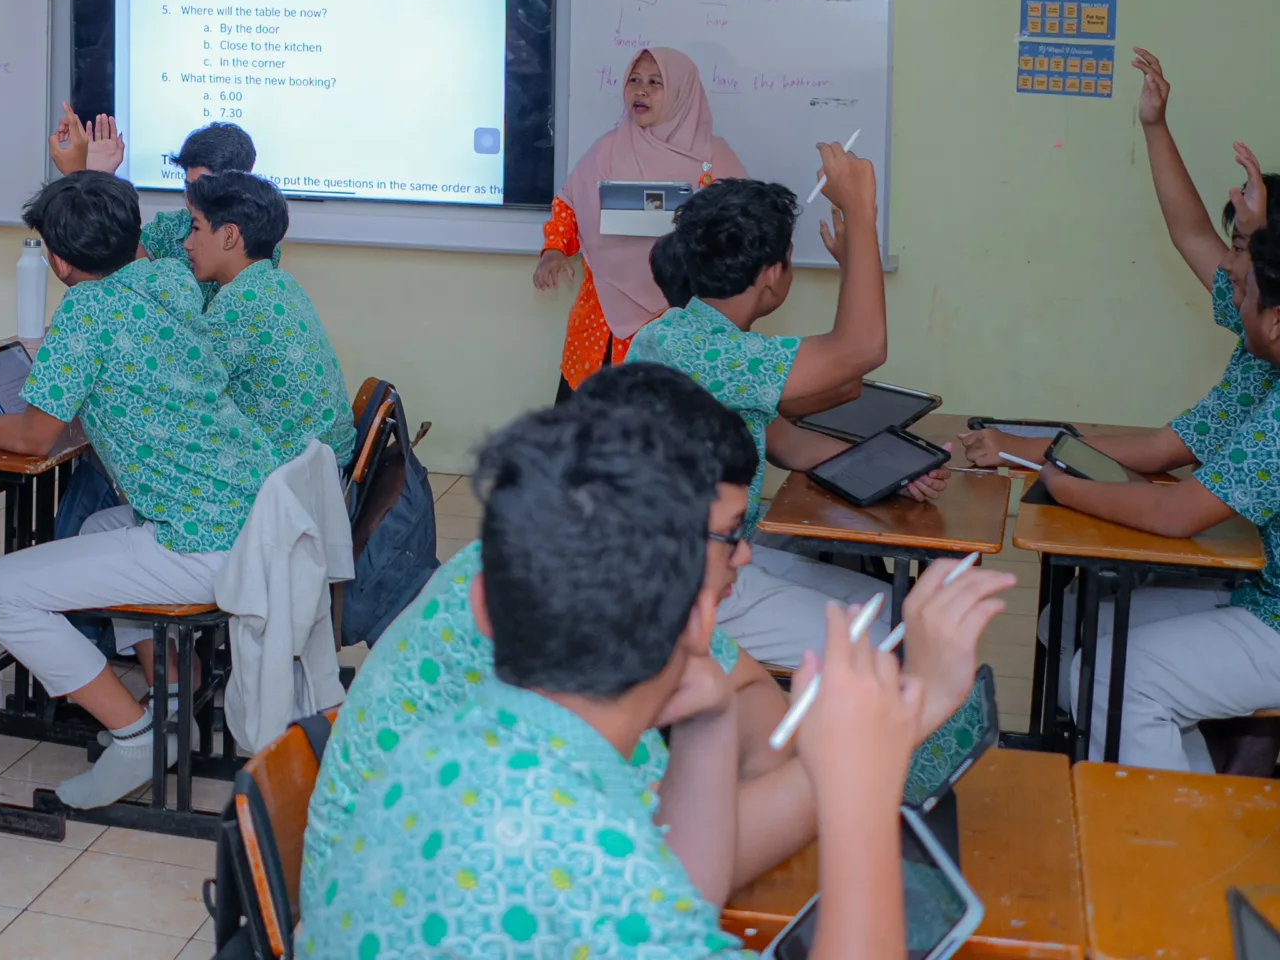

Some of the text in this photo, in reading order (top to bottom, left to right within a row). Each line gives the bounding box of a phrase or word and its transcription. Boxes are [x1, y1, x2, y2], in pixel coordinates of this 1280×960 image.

[161, 5, 327, 18] 5. Where will the table be now?
[203, 24, 280, 35] a. By the door
[203, 40, 323, 53] b. Close to the kitchen
[203, 57, 286, 68] c. In the corner
[161, 72, 337, 90] 6. What time is the new booking?
[595, 66, 618, 89] The
[753, 74, 775, 90] the
[203, 91, 243, 101] a. 6.00
[203, 107, 243, 118] b. 7.30
[161, 169, 186, 180] Write
[271, 175, 281, 185] to
[283, 176, 300, 187] put
[303, 176, 320, 186] the
[323, 178, 374, 190] questions
[376, 179, 386, 189] in
[390, 180, 407, 191] the
[410, 182, 438, 192] same
[441, 183, 471, 193] order
[474, 185, 486, 194] as
